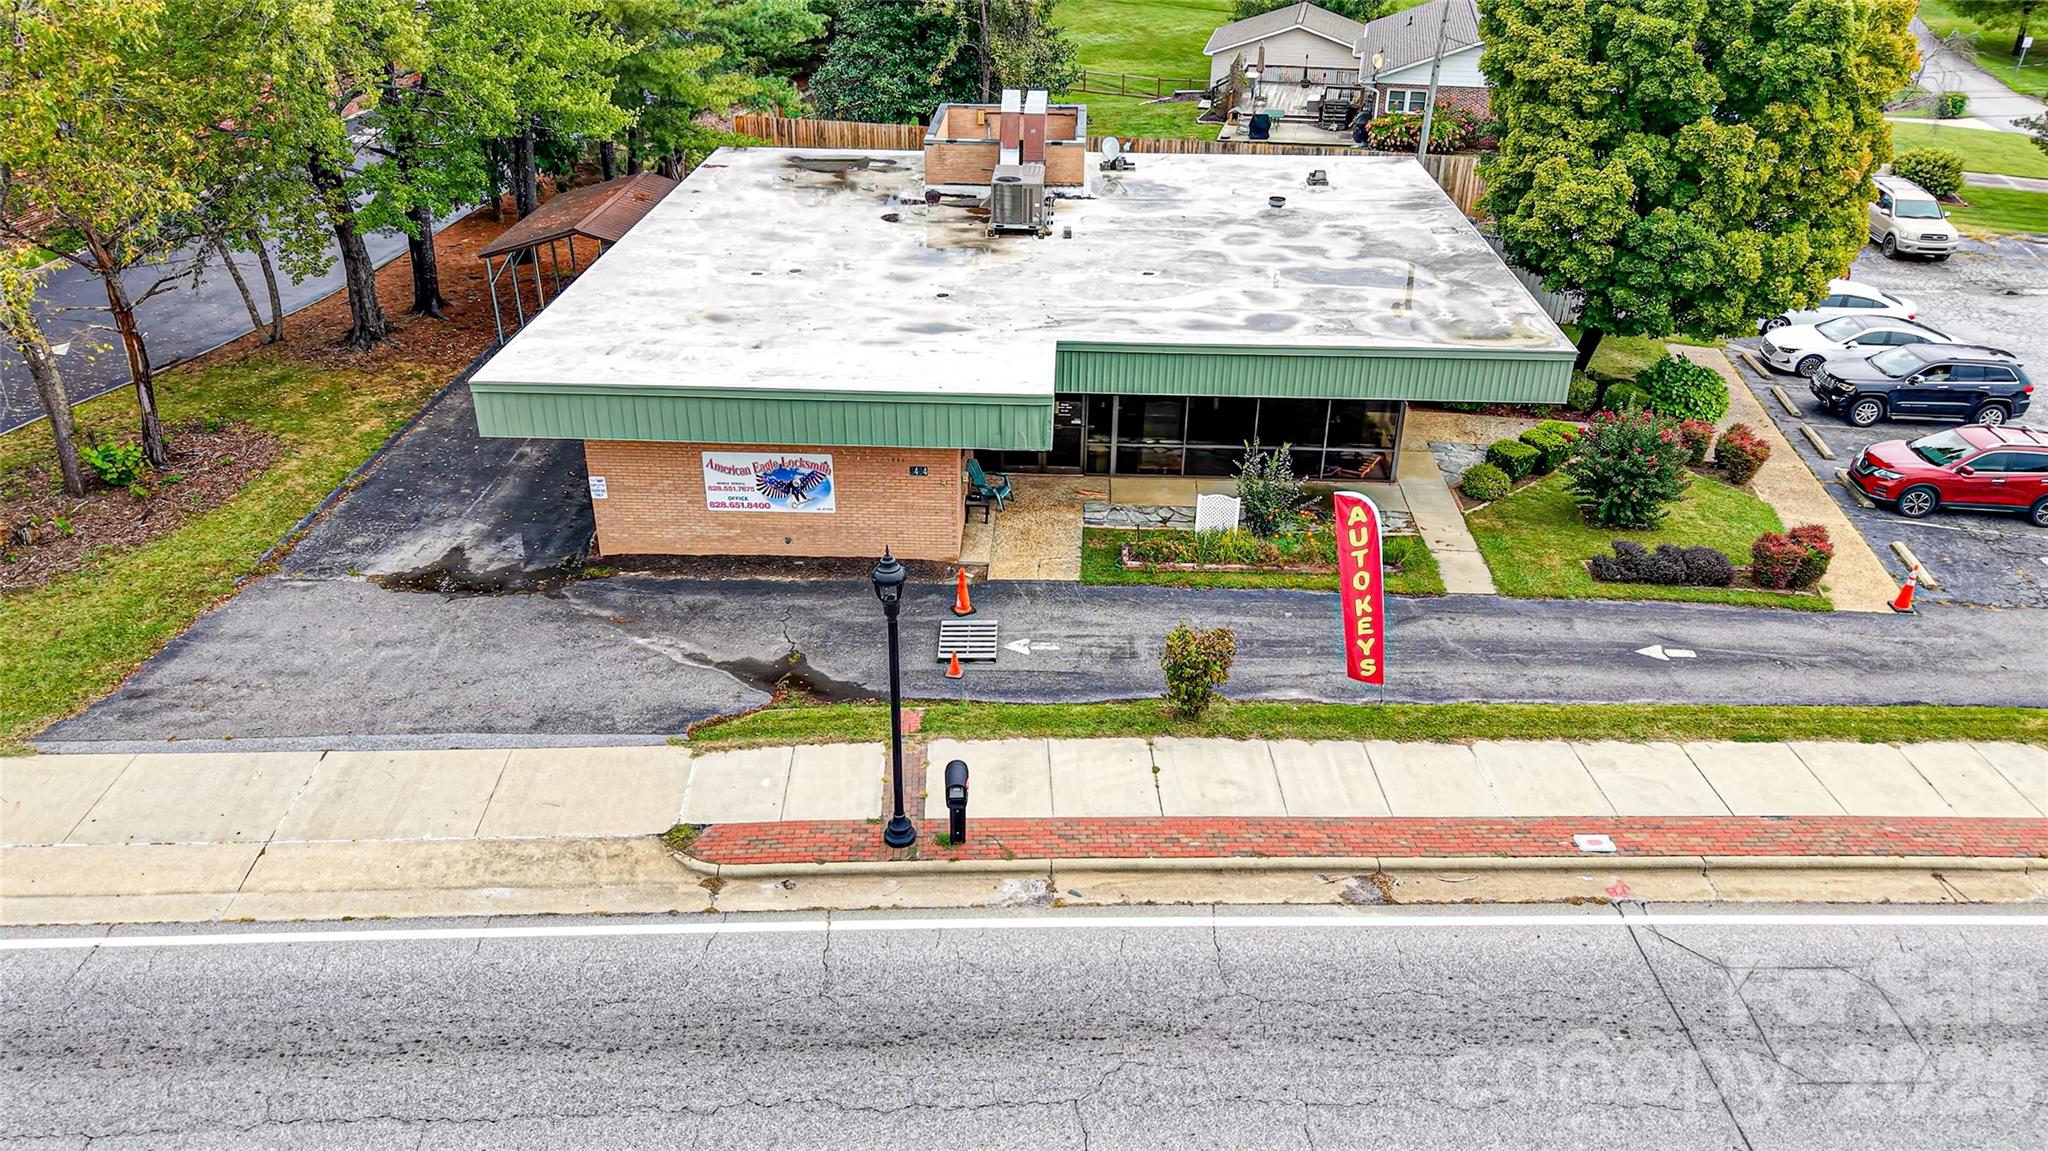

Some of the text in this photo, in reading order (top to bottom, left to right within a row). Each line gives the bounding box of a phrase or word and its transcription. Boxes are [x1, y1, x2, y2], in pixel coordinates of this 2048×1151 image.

[705, 456, 832, 476] American Eagle Locksmith
[709, 501, 772, 510] 828.651.8400
